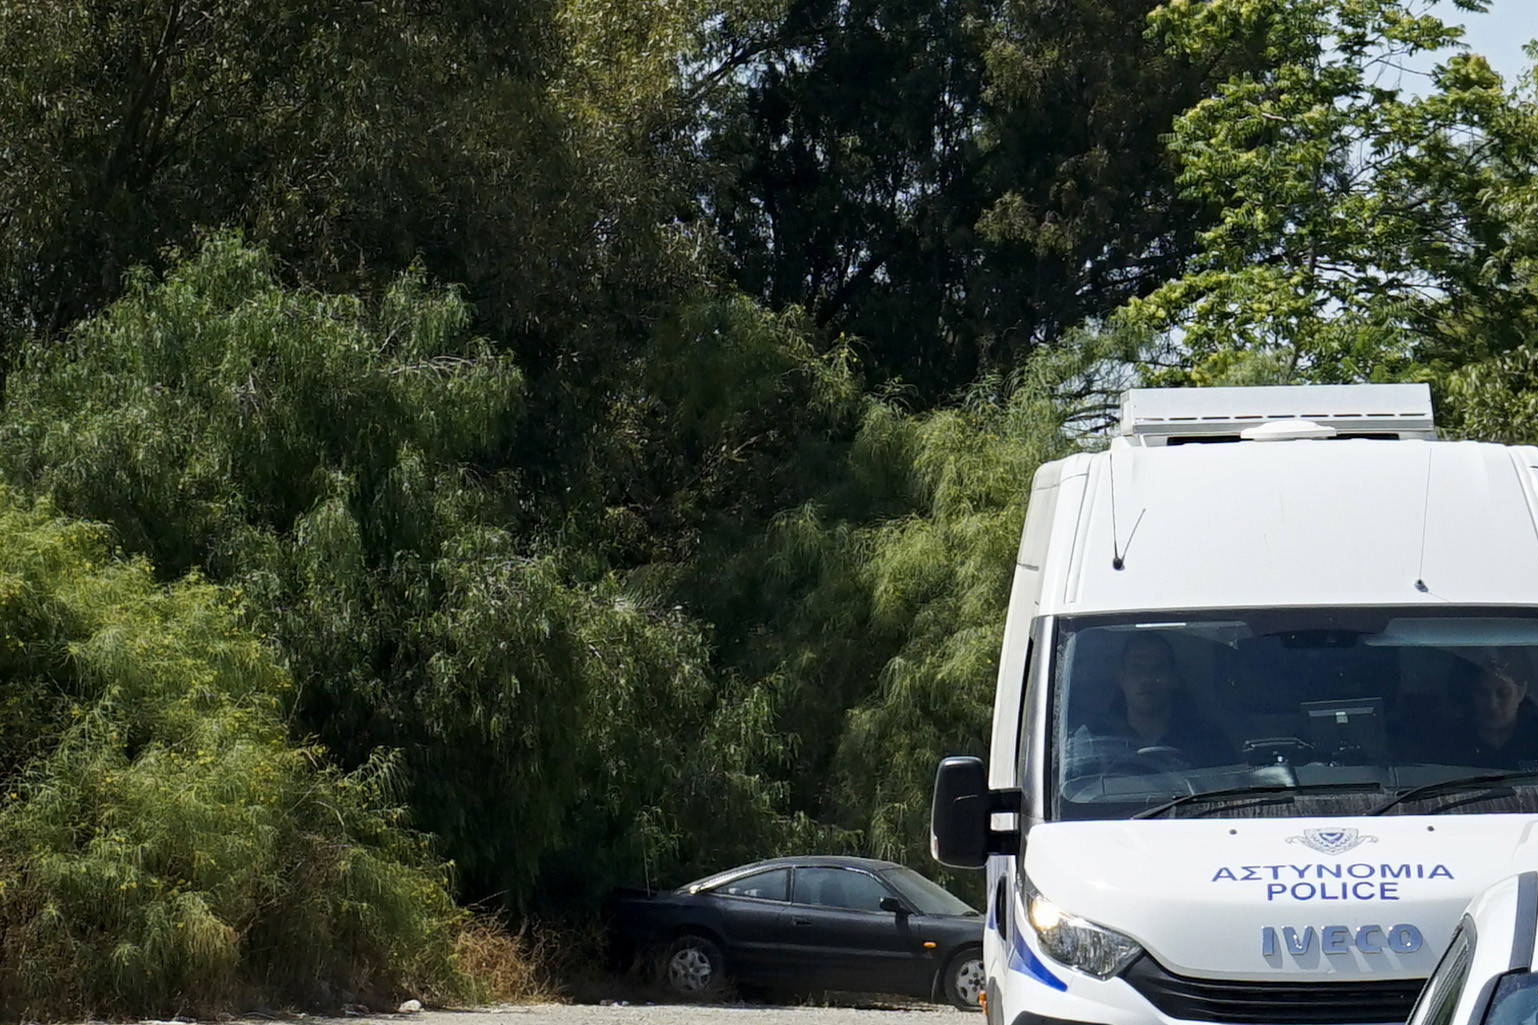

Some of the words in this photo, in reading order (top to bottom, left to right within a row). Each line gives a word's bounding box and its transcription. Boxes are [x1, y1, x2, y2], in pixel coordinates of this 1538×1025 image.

[1211, 863, 1454, 883] ΑΣΤΥΝΟΜΙΑ
[1267, 881, 1400, 901] POLICE
[1261, 923, 1424, 957] IVECO
